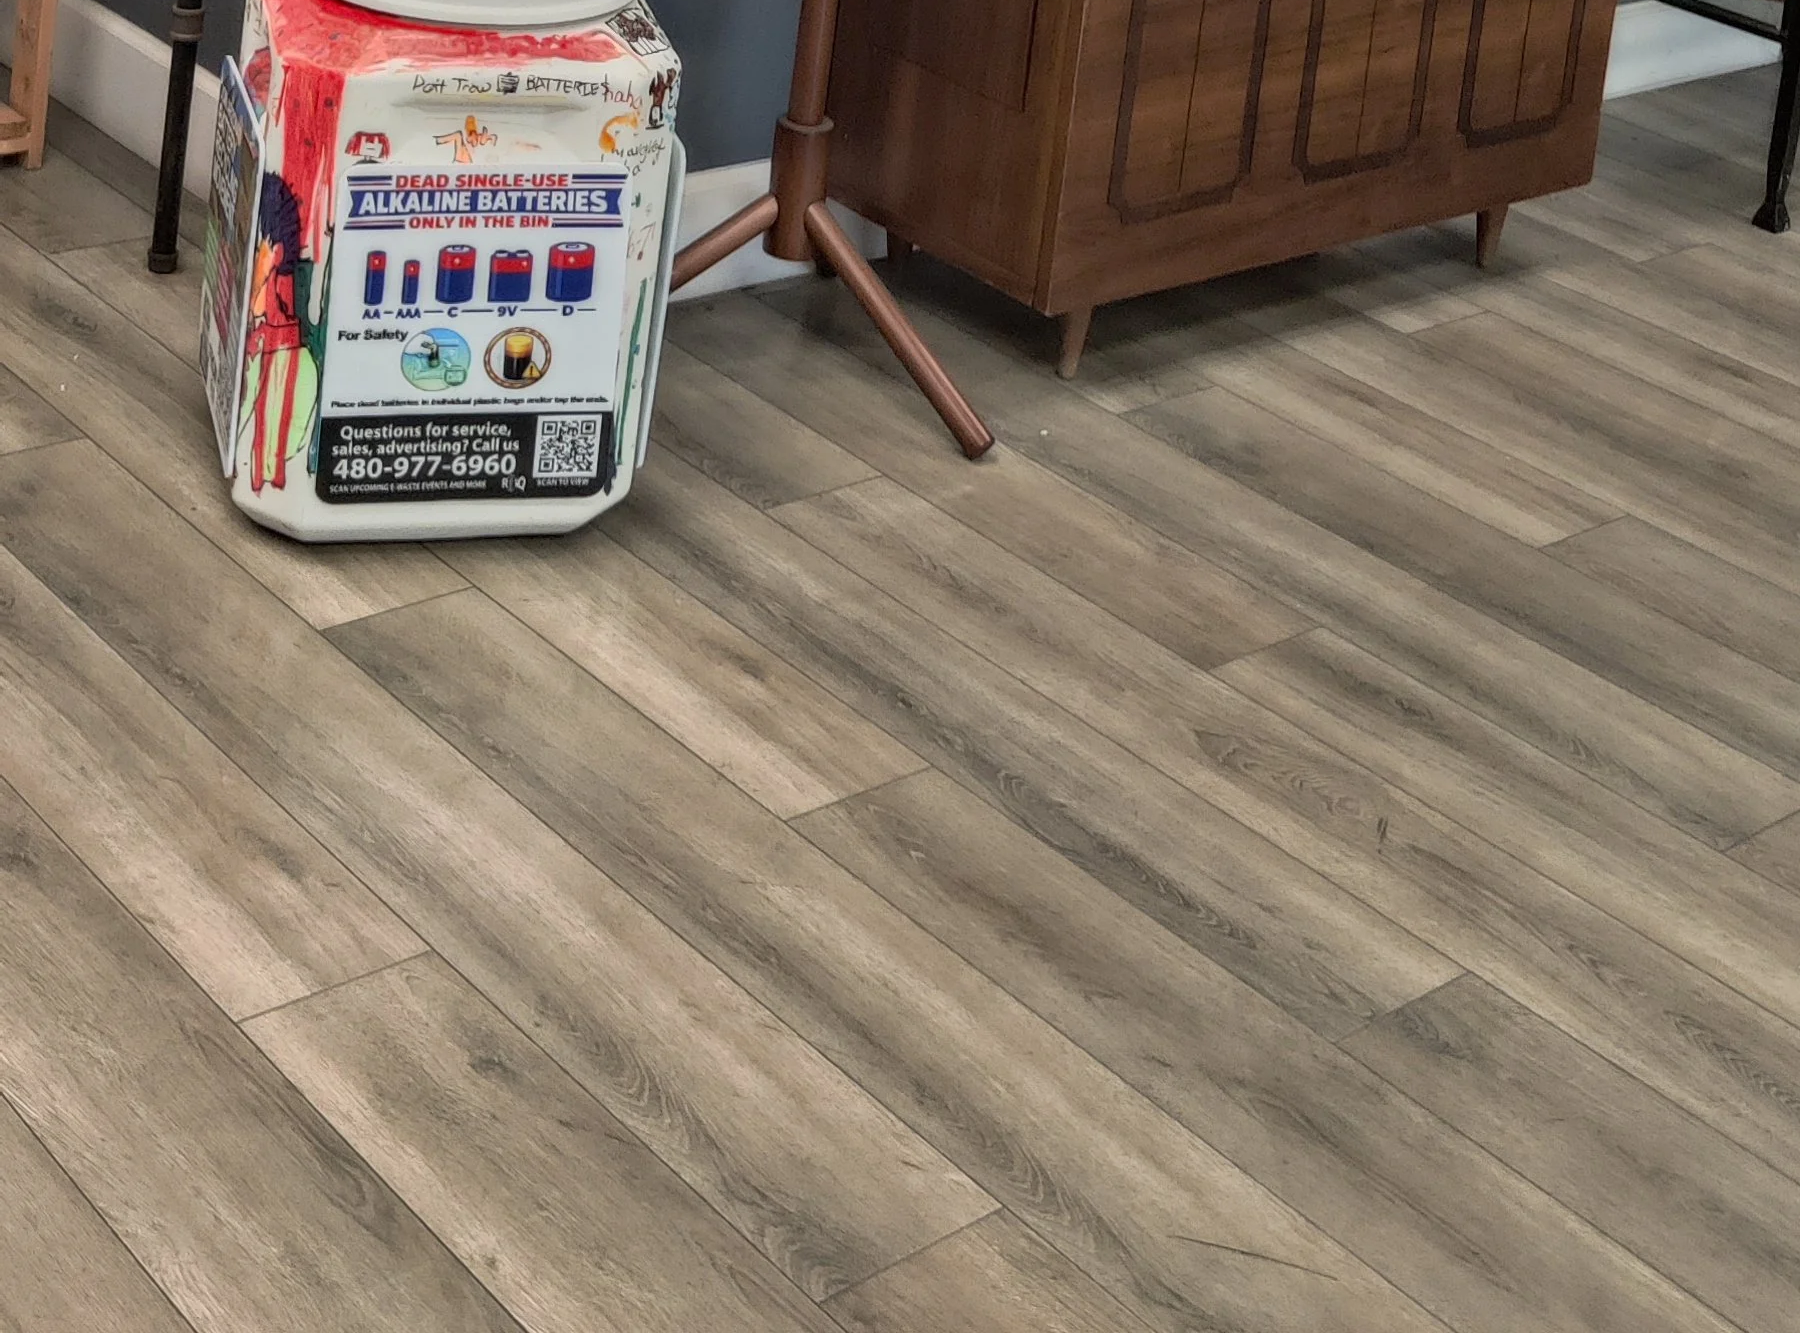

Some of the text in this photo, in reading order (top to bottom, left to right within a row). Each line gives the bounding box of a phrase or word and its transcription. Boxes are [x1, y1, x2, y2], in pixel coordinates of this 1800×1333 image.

[396, 173, 569, 189] DEAD SINGLE-USE
[359, 190, 608, 215] ALKALINE BATTERIES
[409, 215, 550, 229] ONLY IN THE BIN
[362, 309, 381, 320] AA
[396, 308, 421, 319] AAA
[447, 307, 458, 318] C
[497, 306, 518, 317] 9V
[562, 305, 574, 316] D
[338, 328, 409, 342] For Safety
[473, 397, 501, 406] plastic
[570, 395, 585, 403] the
[340, 420, 512, 440] Questions for service,
[331, 437, 520, 456] sales, advertising? Call us
[332, 453, 517, 480] 480-977-6960
